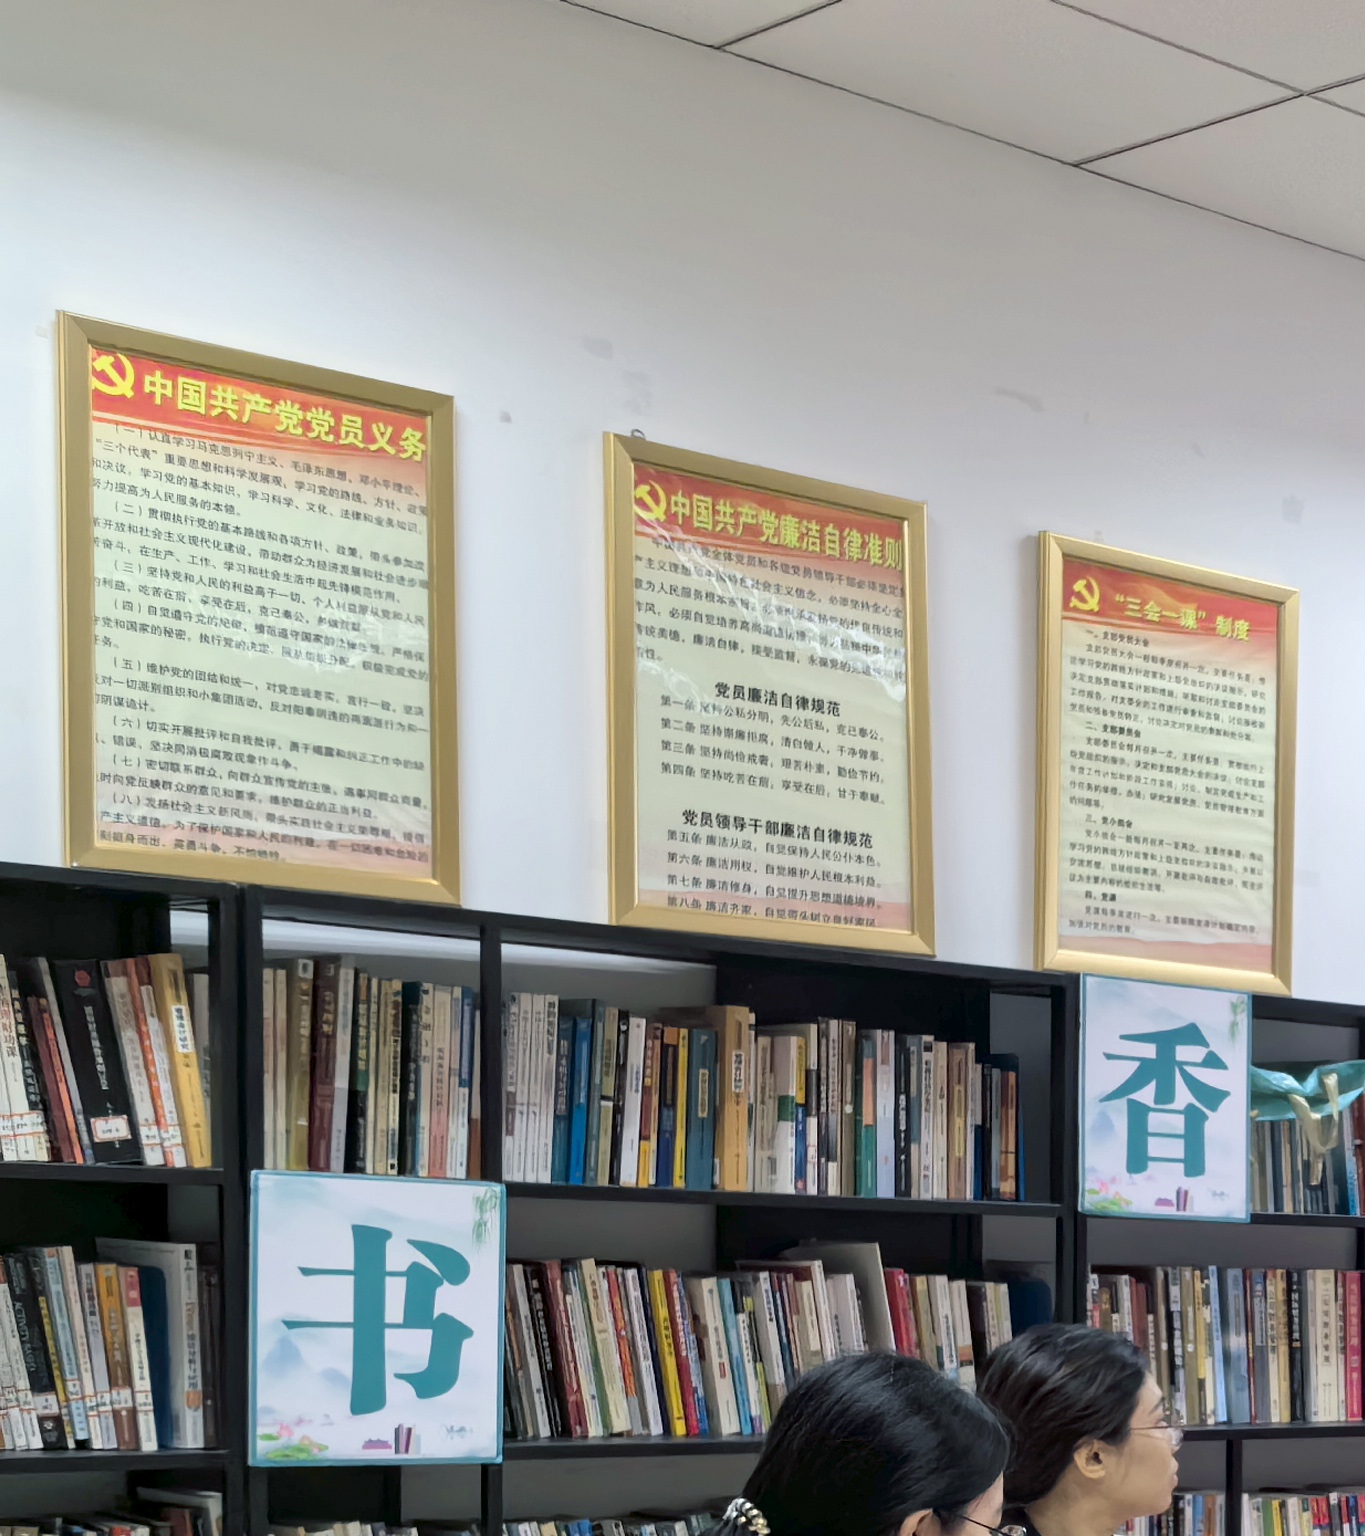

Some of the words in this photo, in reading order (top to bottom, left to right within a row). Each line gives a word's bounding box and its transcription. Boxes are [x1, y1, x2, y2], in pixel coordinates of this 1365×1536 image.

[143, 370, 427, 462] 中国共产党党员义务
[670, 489, 903, 572] 中国共产党廉洁自律准则
[1115, 591, 1205, 633] “三会一课”
[1216, 612, 1249, 643] 制度
[714, 680, 840, 718] 党员廉洁自律规范
[682, 807, 872, 850] 党员领导干部廉洁自律规范
[1099, 1022, 1231, 1178] 香
[281, 1224, 474, 1416] 书
